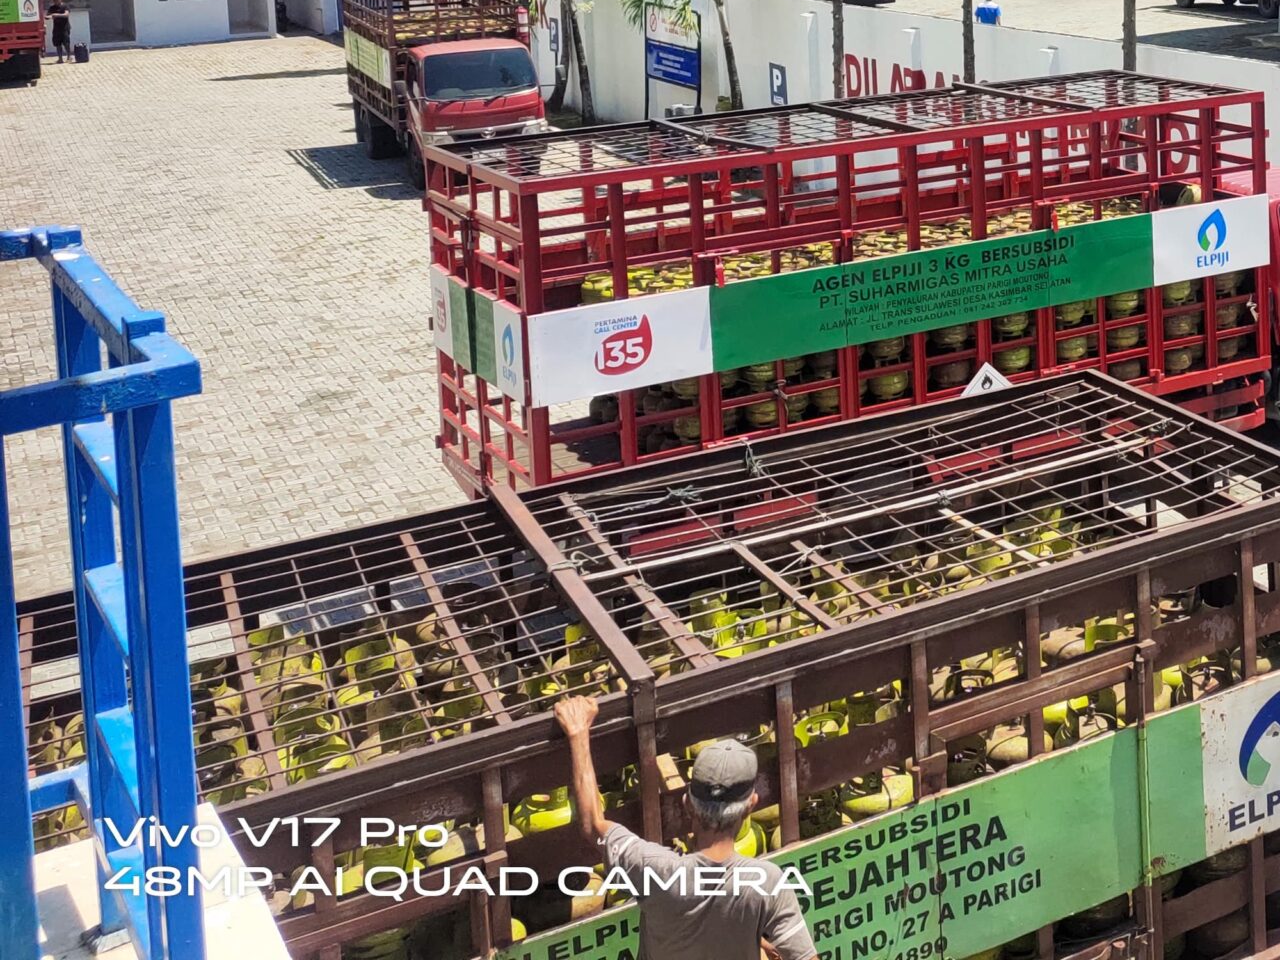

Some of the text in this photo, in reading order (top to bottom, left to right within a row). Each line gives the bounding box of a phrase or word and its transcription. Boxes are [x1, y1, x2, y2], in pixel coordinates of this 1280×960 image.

[772, 68, 782, 93] P
[812, 235, 1075, 293] AGEN ELPIJI 3 KG BERSUBSIDI
[1196, 251, 1229, 268] ELPIJI
[820, 253, 1068, 309] PT. SUHARMIGAS MITRA USAHA
[886, 292, 939, 308] PENYALURAN
[941, 283, 985, 299] KABUPATEN
[987, 279, 1011, 293] PARIGI
[595, 315, 637, 327] PERTAMINA
[881, 306, 913, 320] TRANS
[915, 296, 960, 313] SULAWESI
[963, 293, 986, 306] DESA
[897, 309, 956, 326] PENGADUAN
[594, 321, 637, 334] CALL CENTER
[597, 336, 645, 370] 135
[813, 845, 1026, 943] RIGI MOUTONG
[903, 910, 930, 940] 27
[938, 902, 956, 925] A
[963, 869, 1041, 916] PARIGI
[548, 919, 639, 960] ELPI
